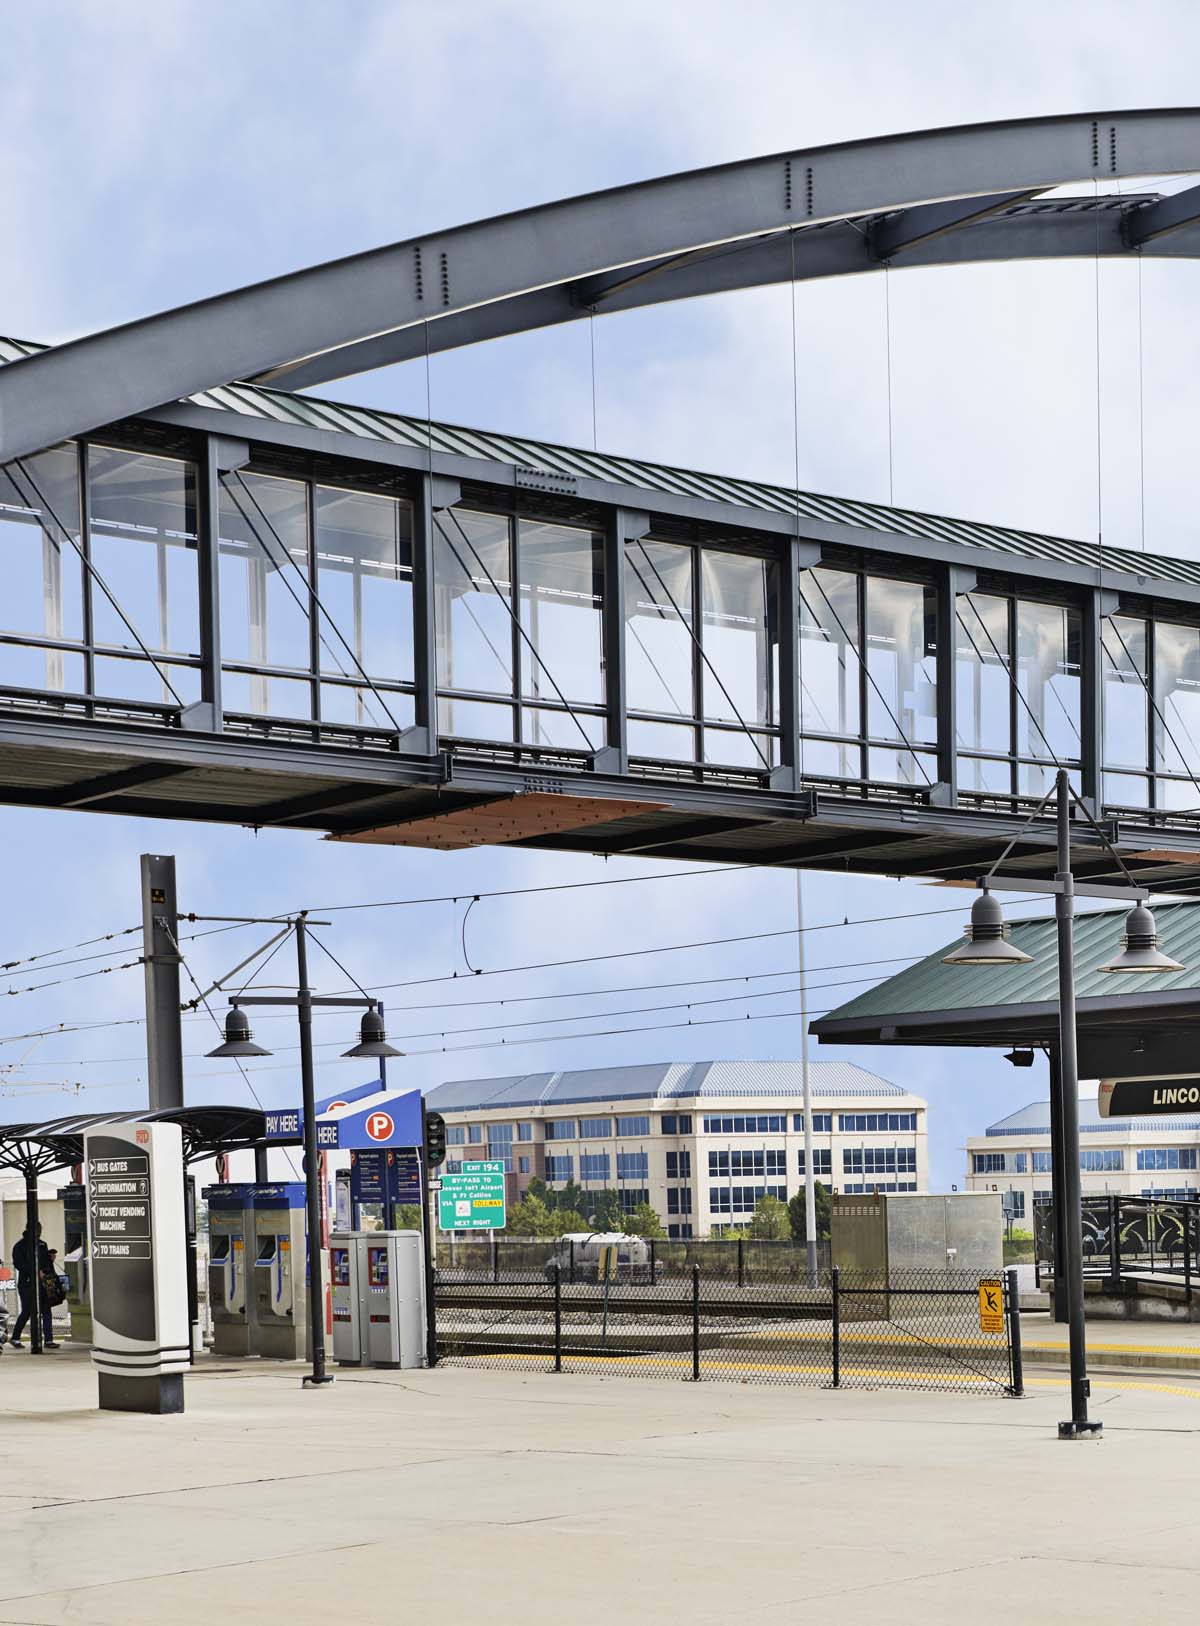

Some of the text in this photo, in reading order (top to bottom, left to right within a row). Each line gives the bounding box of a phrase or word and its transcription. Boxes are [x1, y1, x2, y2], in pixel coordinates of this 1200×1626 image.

[266, 1115, 298, 1133] PAY HERE
[373, 1116, 388, 1136] P
[318, 1126, 337, 1144] HERE
[97, 1161, 128, 1172] BUS GATES
[483, 1163, 499, 1171] 194
[98, 1182, 137, 1193] INFORMATION
[480, 1184, 503, 1192] Airport
[99, 1206, 145, 1217] TICKET VENDING
[100, 1221, 126, 1231] MACHINE
[100, 1245, 130, 1255] TO TRAINS
